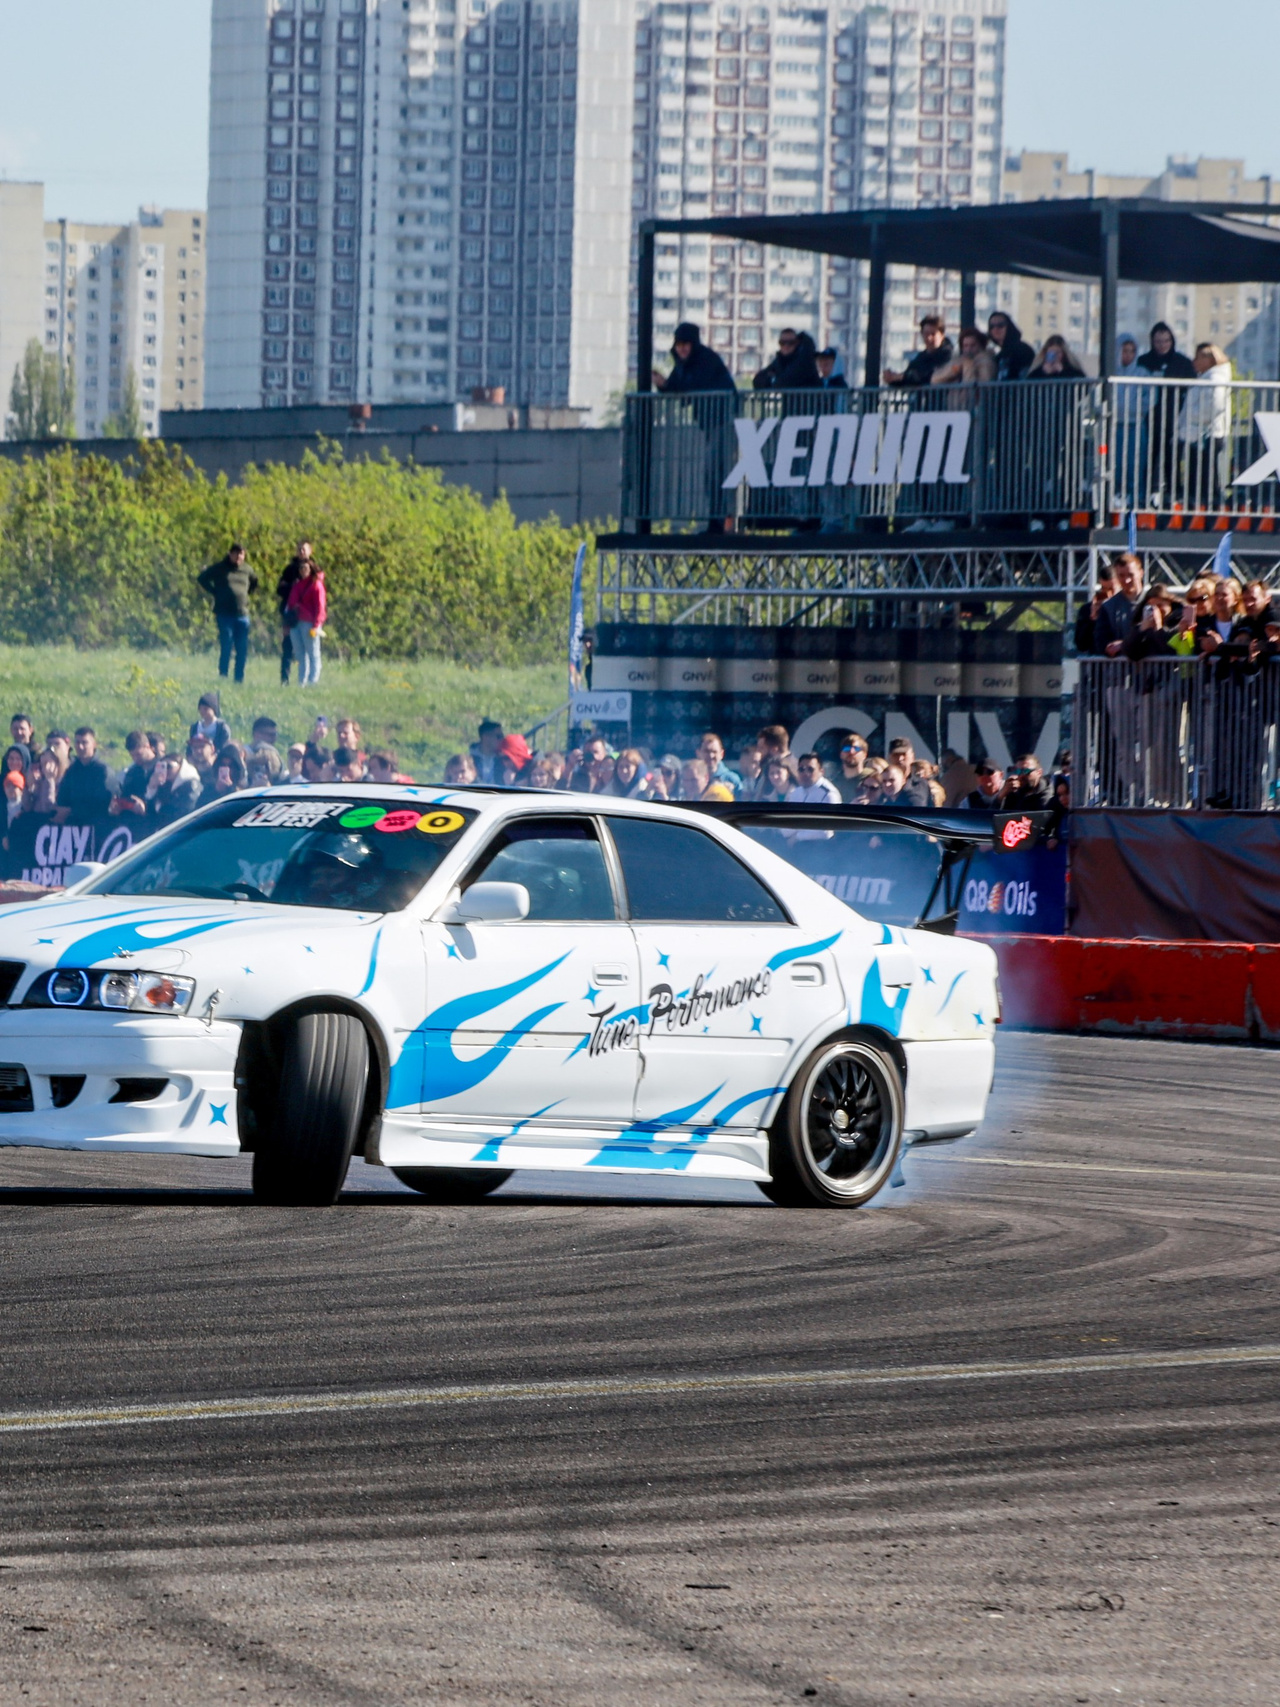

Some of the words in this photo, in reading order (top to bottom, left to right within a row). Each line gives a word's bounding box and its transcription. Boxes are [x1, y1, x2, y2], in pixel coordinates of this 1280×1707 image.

[721, 411, 971, 489] XENUM
[576, 703, 602, 715] GNV
[965, 879, 988, 913] Q8
[1003, 879, 1038, 917] Oils
